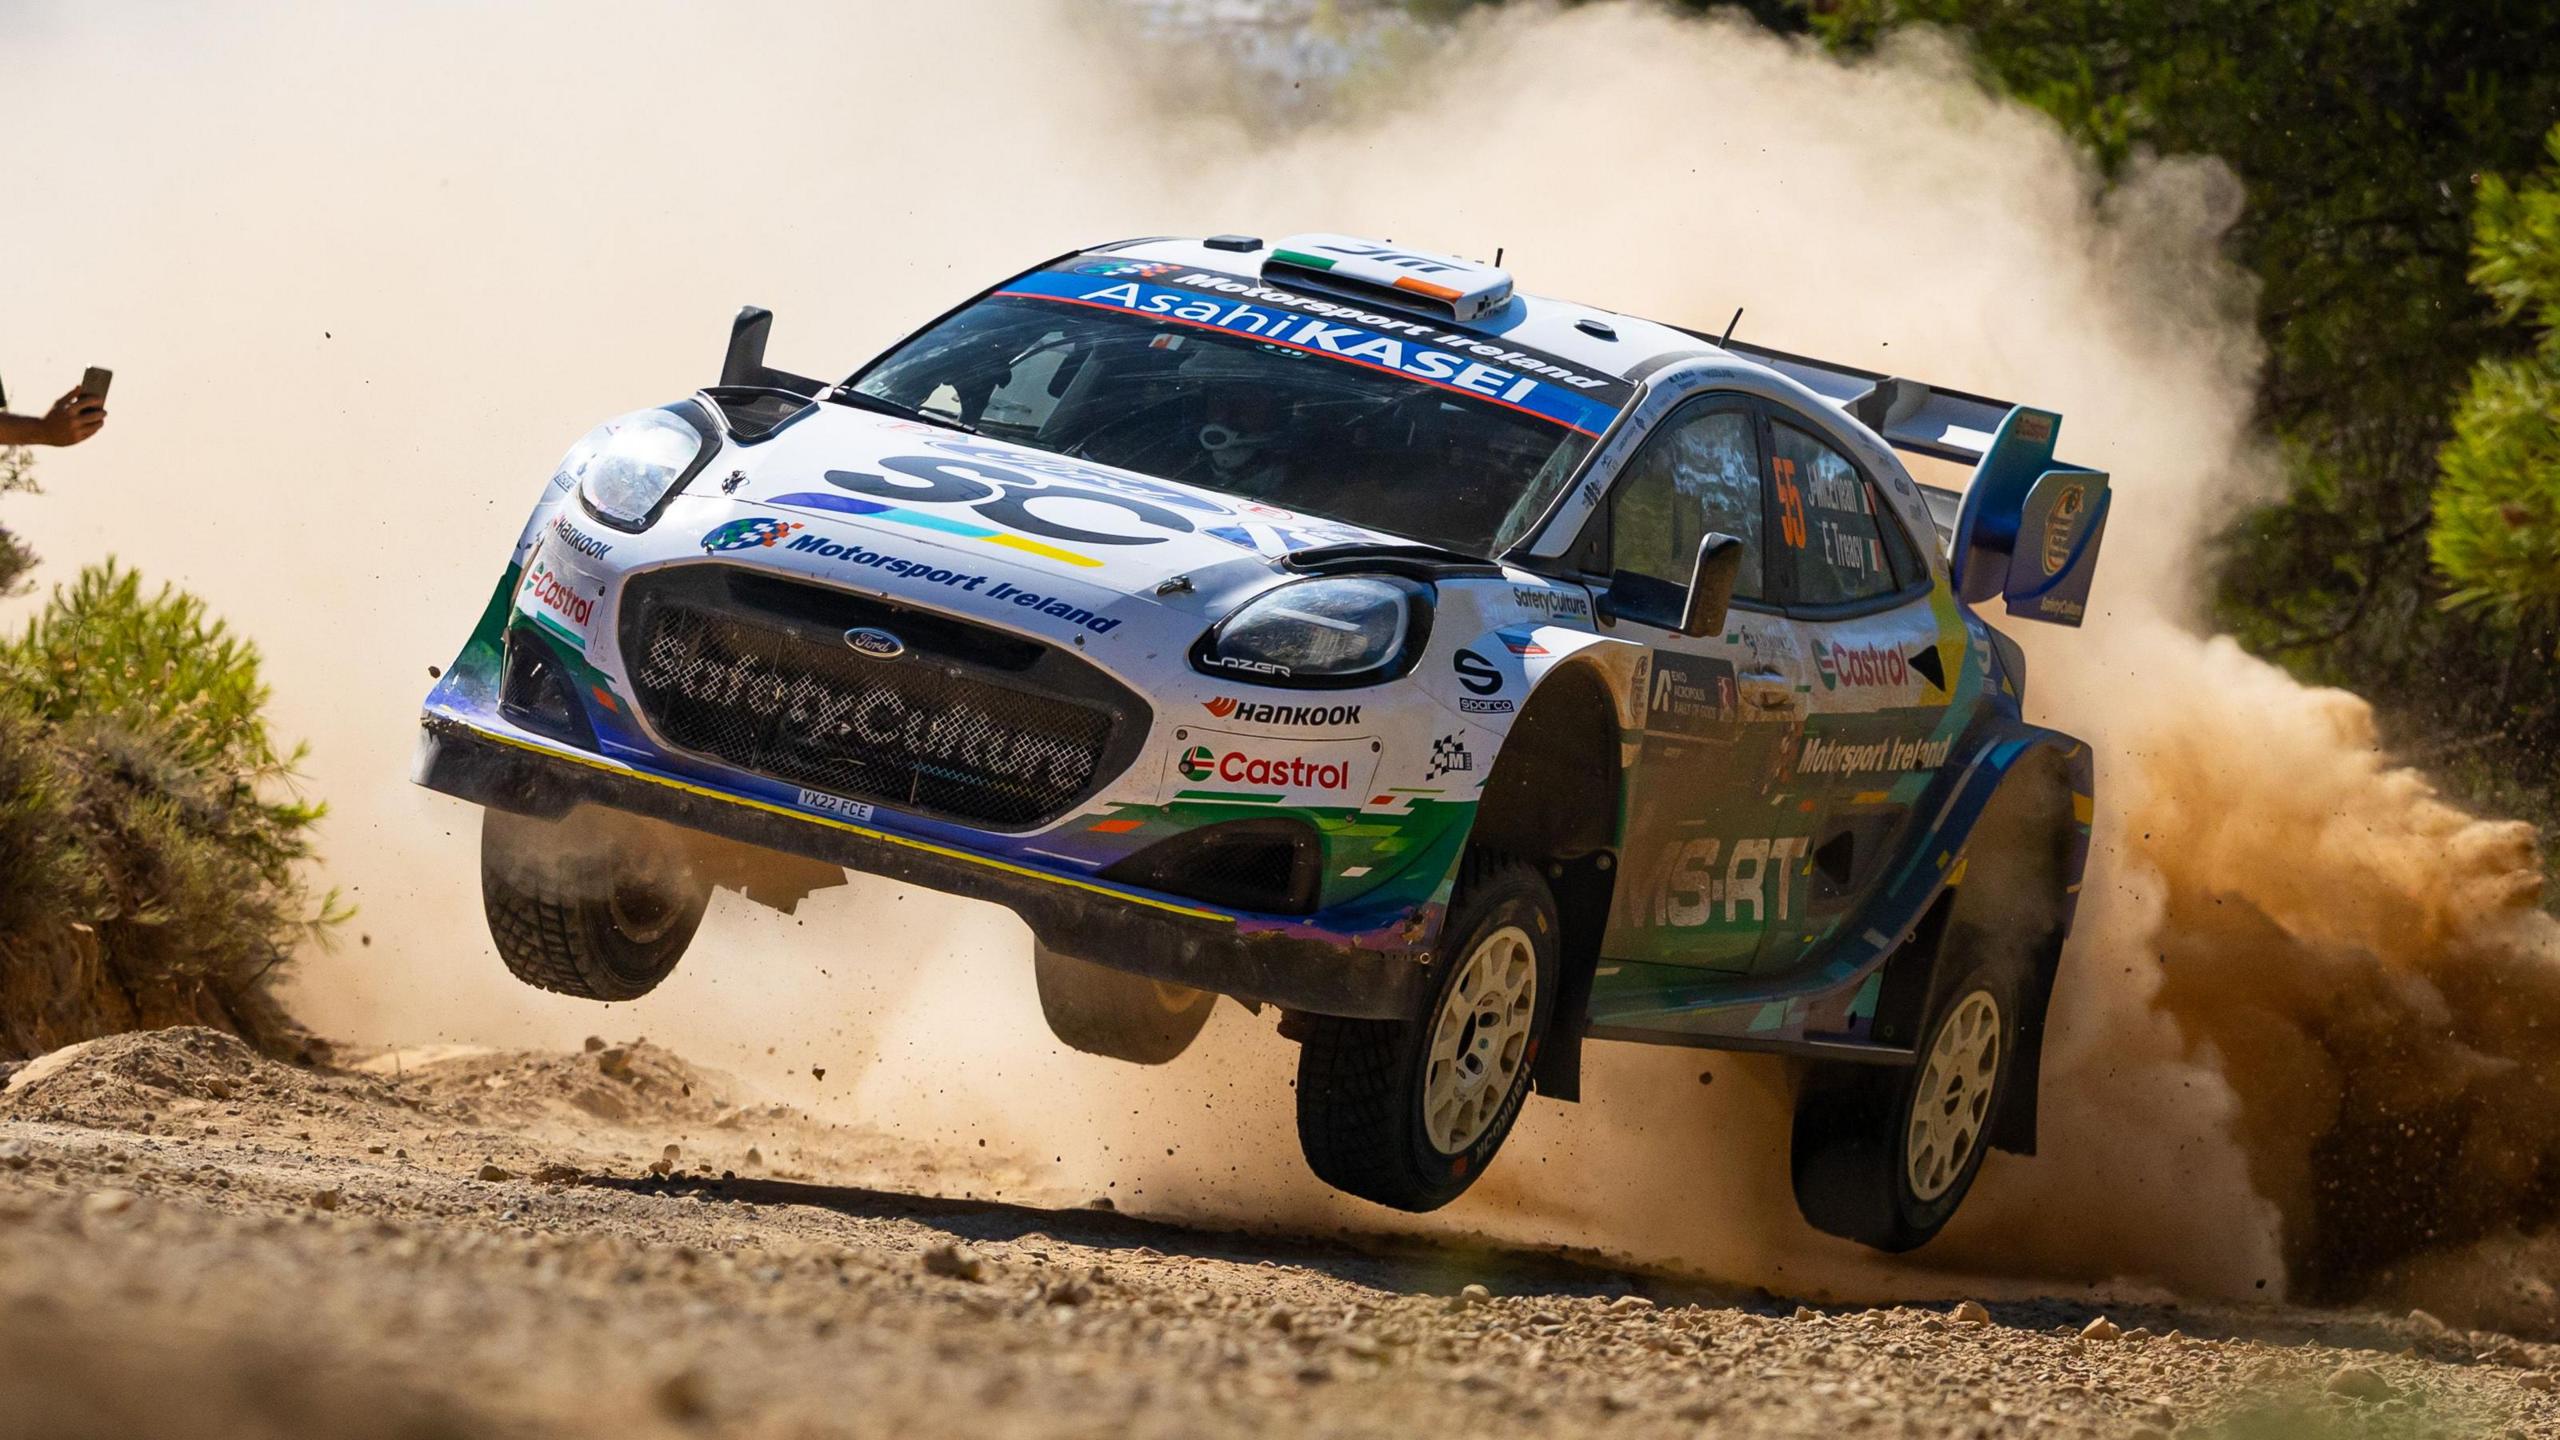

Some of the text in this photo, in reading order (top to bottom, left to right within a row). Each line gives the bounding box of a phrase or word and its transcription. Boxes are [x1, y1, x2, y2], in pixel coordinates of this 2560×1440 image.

[1172, 272, 1611, 391] Motorsport Ireland
[1772, 456, 1806, 550] 55
[1831, 523, 1865, 579] Treacy
[534, 571, 594, 627] Castrol
[786, 534, 1122, 635] Motorsport Ireland
[1513, 587, 1587, 616] SafetyCulture
[854, 631, 892, 654] Ford
[1832, 641, 1909, 690] Castrol
[1462, 699, 1512, 712] sparco
[1219, 751, 1350, 790] Castrol
[1797, 733, 1954, 778] Motorsport Ireland
[803, 790, 868, 818] YX22 FCE
